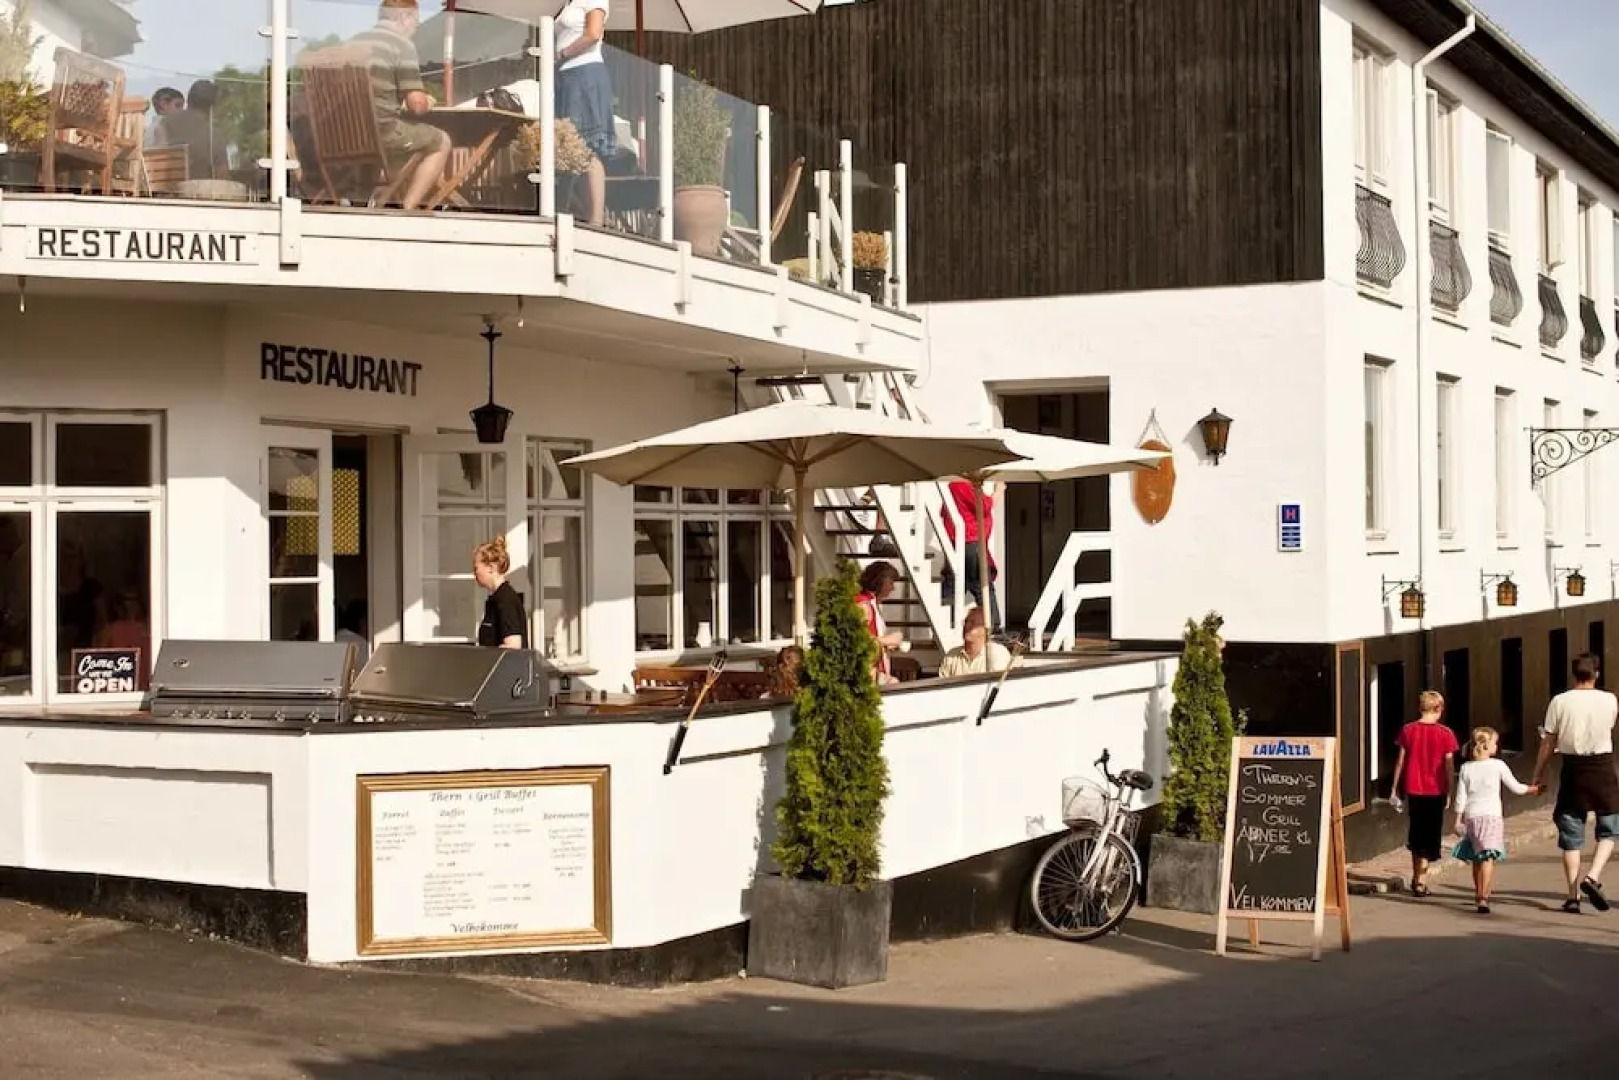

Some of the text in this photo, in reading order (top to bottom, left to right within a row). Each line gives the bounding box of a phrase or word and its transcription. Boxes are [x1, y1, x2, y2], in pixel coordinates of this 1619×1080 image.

[38, 228, 247, 262] RESTAURANT
[261, 342, 422, 397] RESTAURANT
[79, 654, 133, 675] Come In
[78, 677, 133, 693] OPEN
[1253, 740, 1311, 756] LAVAZZA
